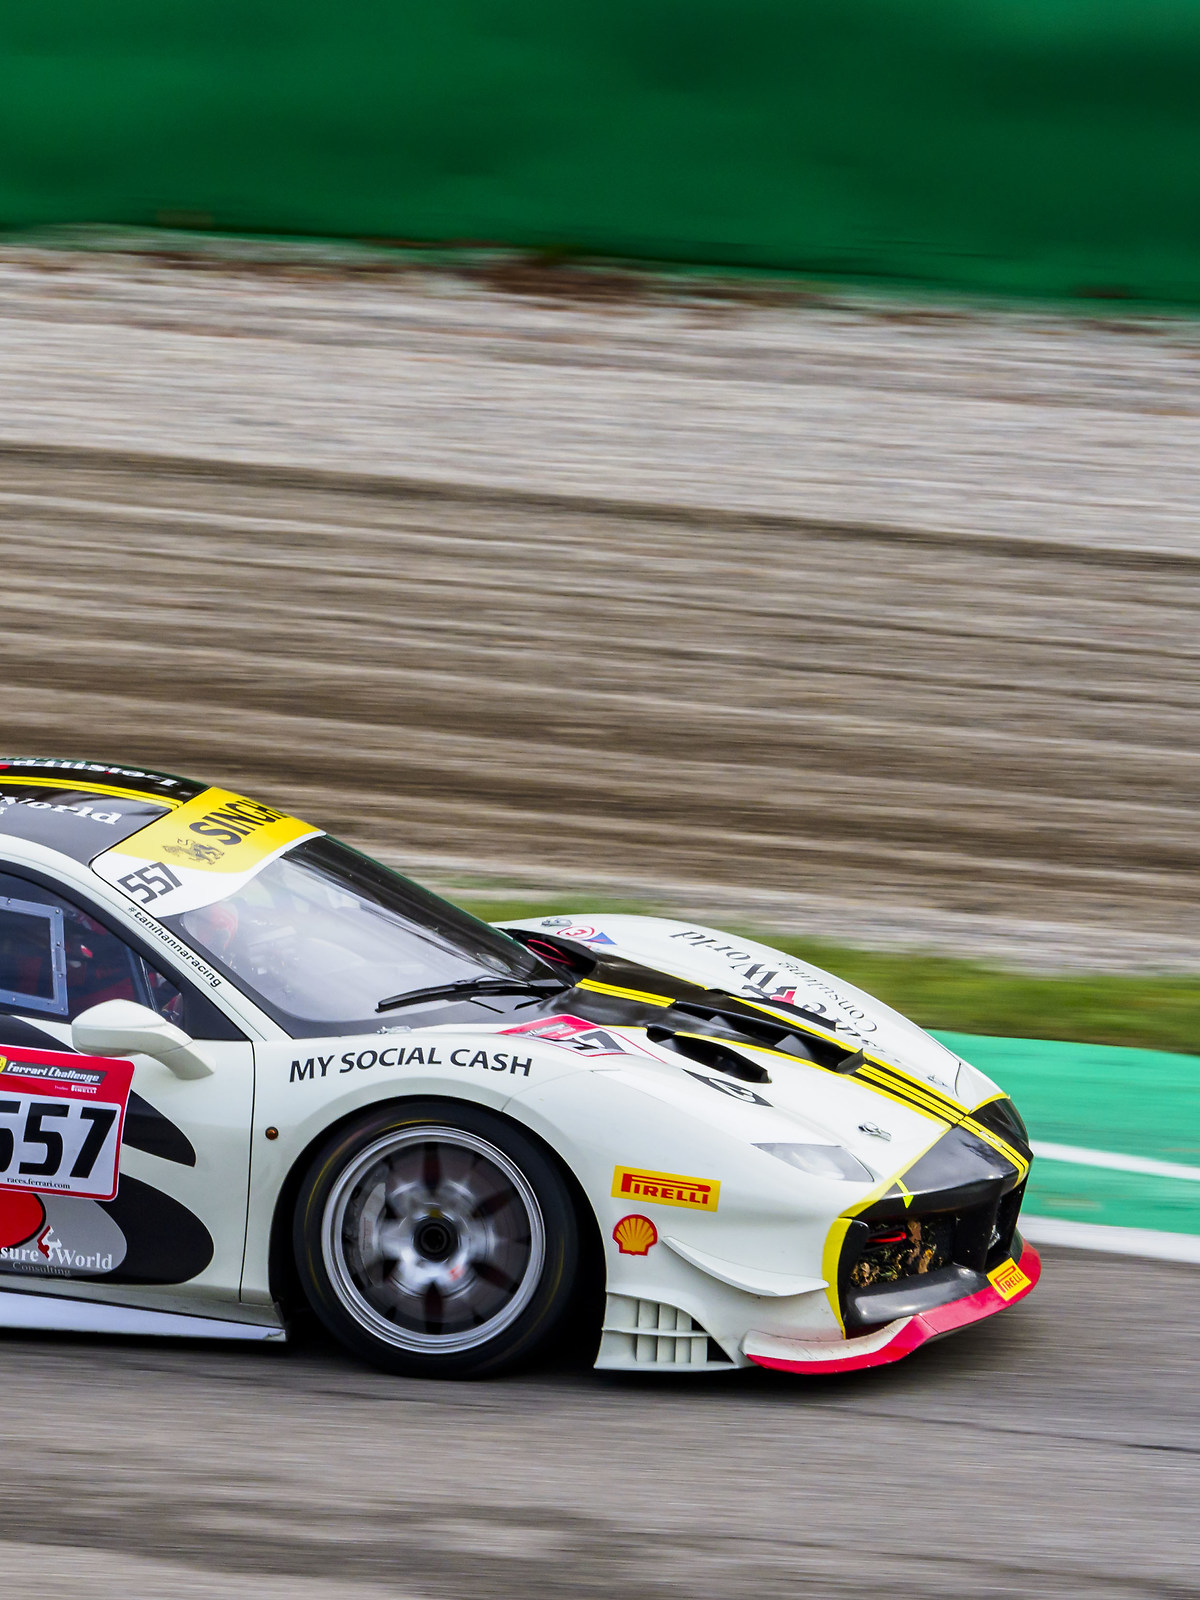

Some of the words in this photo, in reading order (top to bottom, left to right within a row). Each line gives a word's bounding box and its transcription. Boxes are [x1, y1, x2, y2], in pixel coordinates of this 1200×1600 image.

[116, 861, 183, 905] 557
[7, 1061, 49, 1076] Ferrari
[48, 1066, 100, 1083] Challenge
[289, 1056, 335, 1083] MY
[339, 1047, 443, 1074] SOCIAL
[449, 1048, 533, 1077] CASH
[6, 1177, 72, 1190] races.ferrari.com
[620, 1172, 712, 1205] PIRELLI
[12, 1261, 72, 1277] Consulting
[55, 1247, 113, 1270] World
[993, 1265, 1025, 1294] PIRELLI
